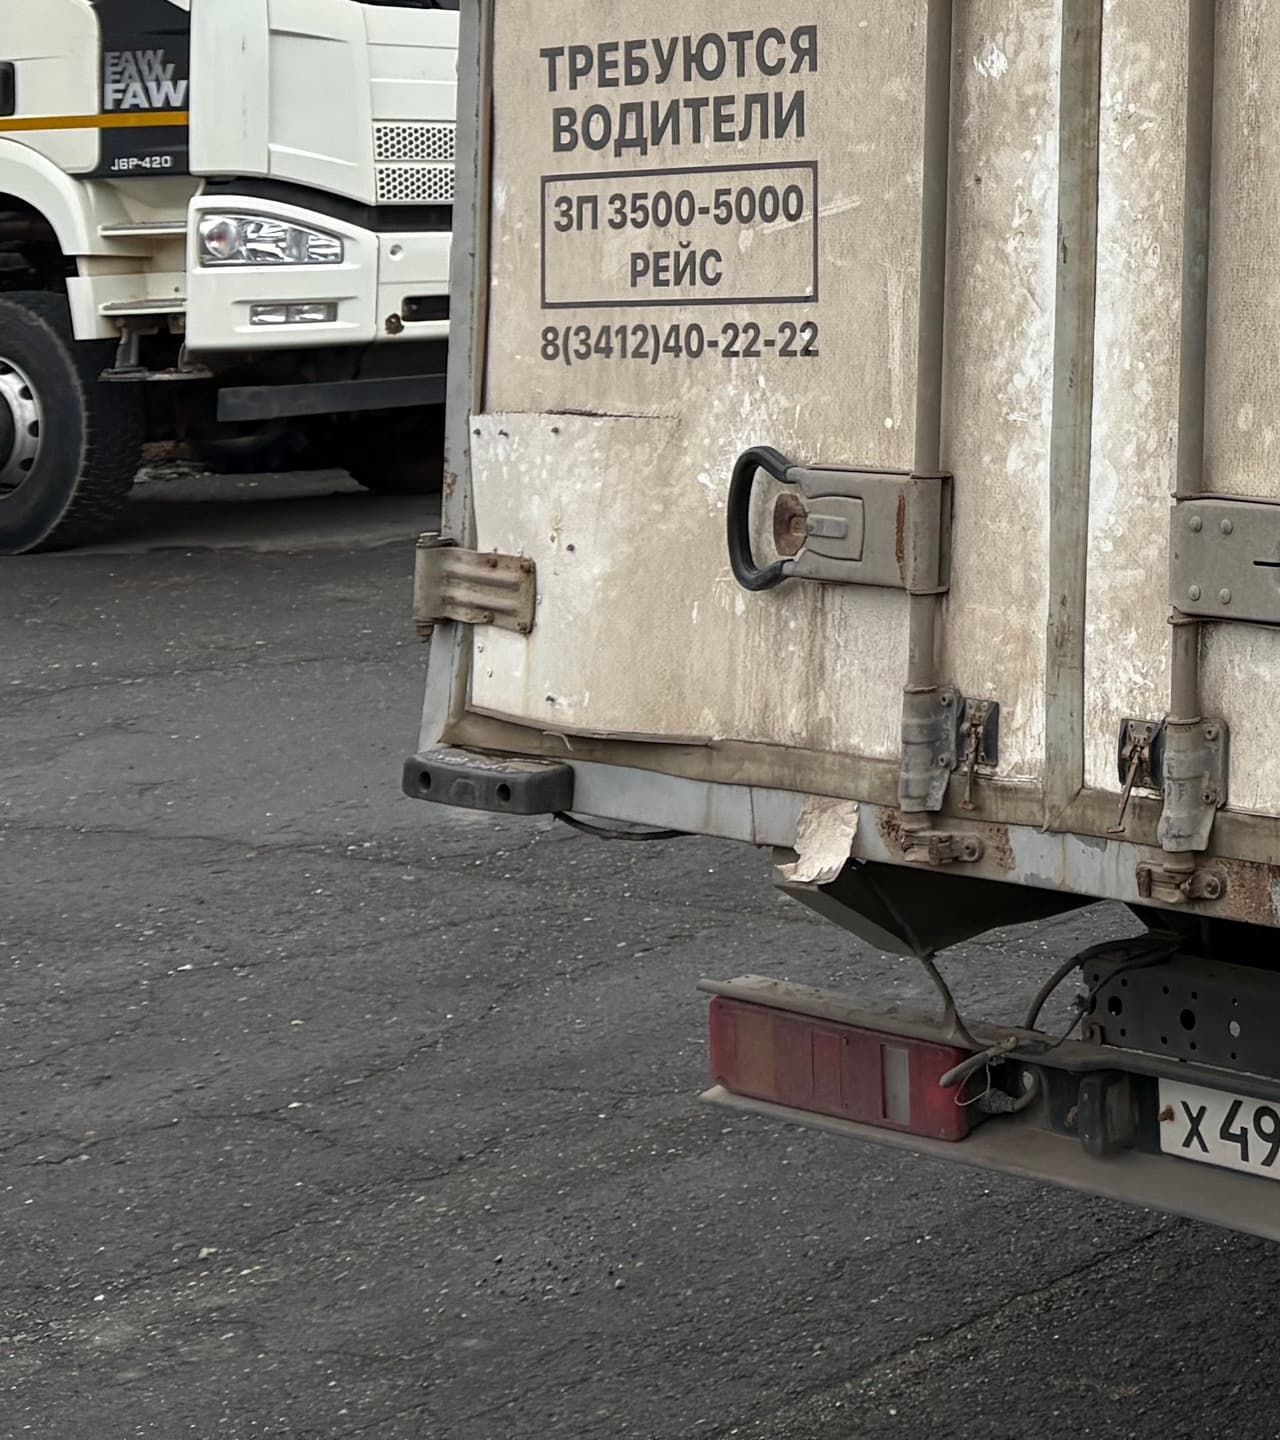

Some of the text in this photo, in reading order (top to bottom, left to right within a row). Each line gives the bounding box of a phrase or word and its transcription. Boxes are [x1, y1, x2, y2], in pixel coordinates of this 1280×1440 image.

[539, 24, 818, 92] ТРЕБУЮТСЯ
[103, 80, 188, 110] FAW
[552, 90, 806, 158] ВОДИТЕЛИ
[553, 184, 804, 233] ЗП 3500-5000
[630, 240, 723, 288] РЕЙС
[540, 320, 820, 365] 8(3412)40-22-22
